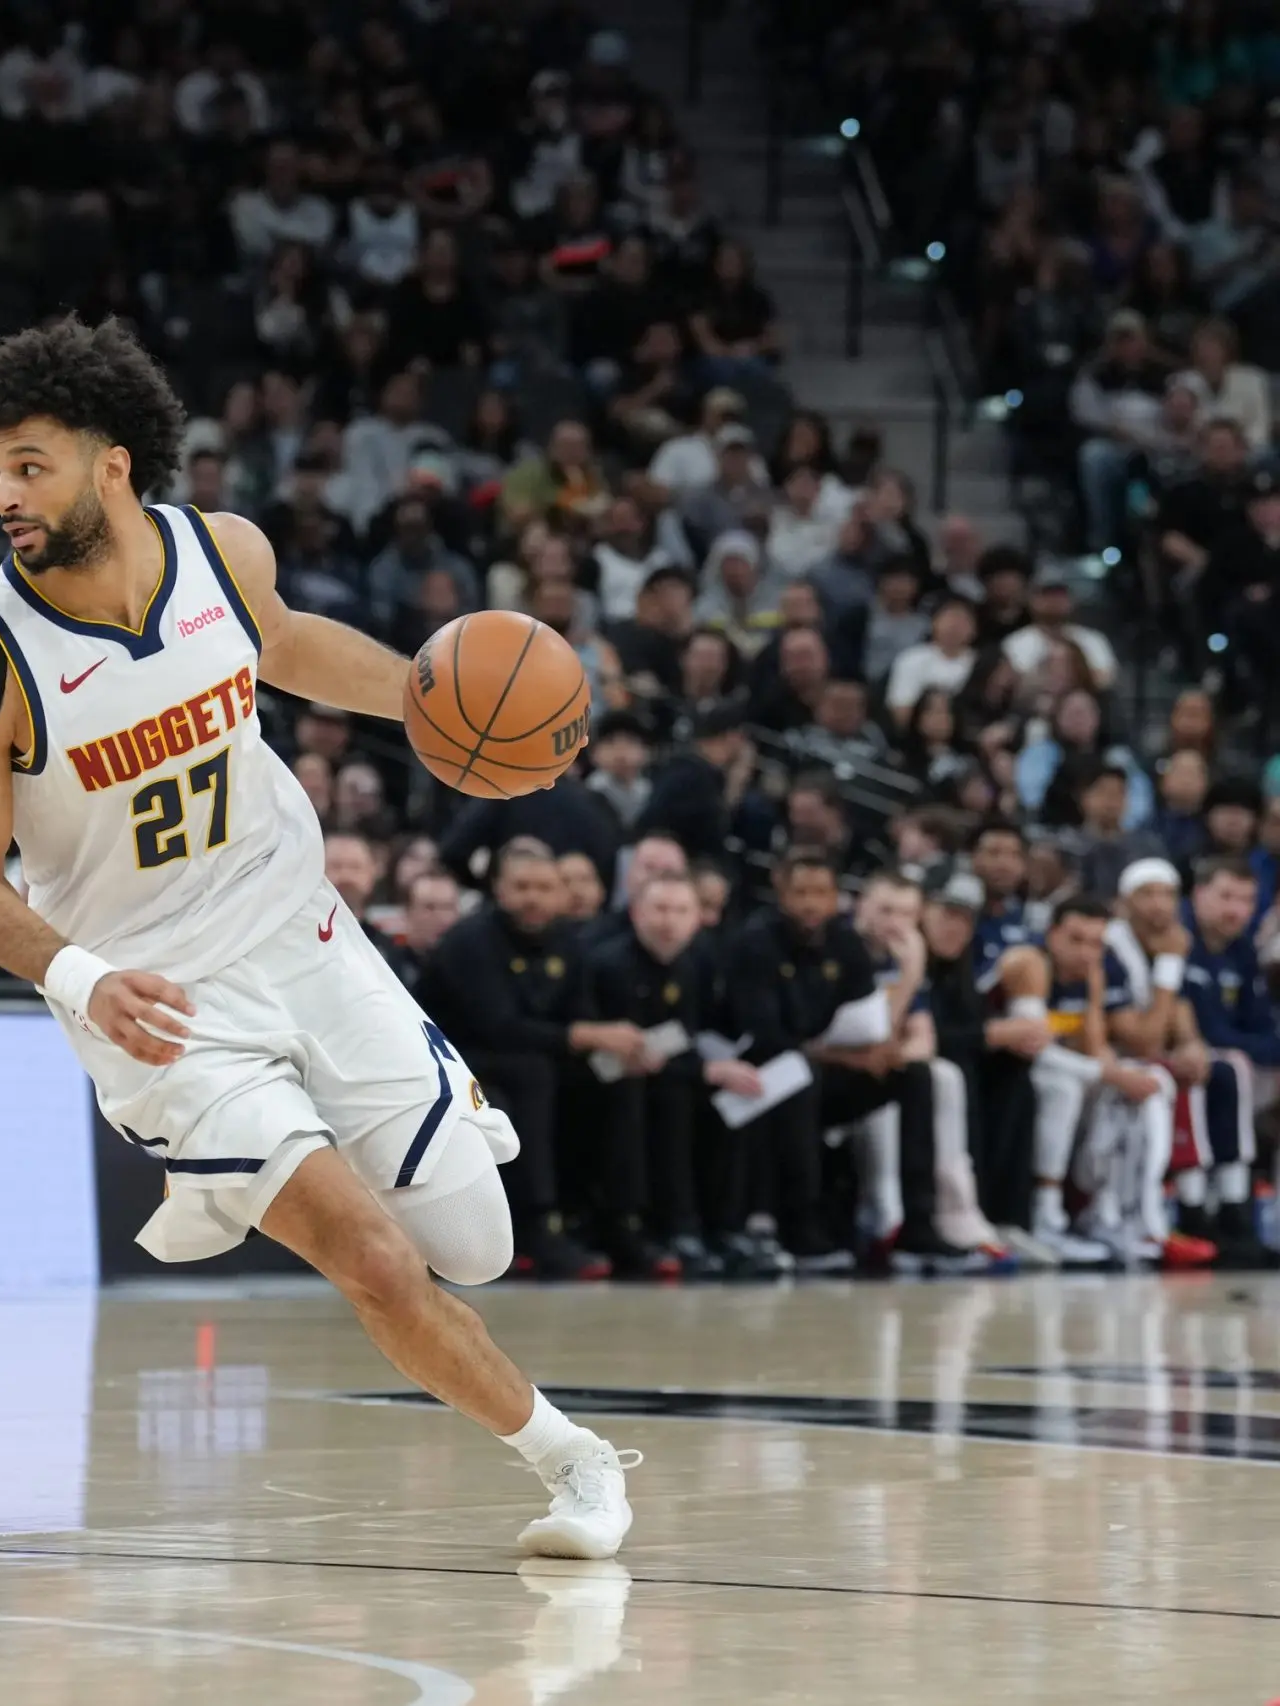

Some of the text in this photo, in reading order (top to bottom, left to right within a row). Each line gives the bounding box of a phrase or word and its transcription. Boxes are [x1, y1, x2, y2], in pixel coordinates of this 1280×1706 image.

[177, 605, 225, 638] ibotta
[65, 664, 256, 793] NUGGETS
[130, 744, 233, 872] 27
